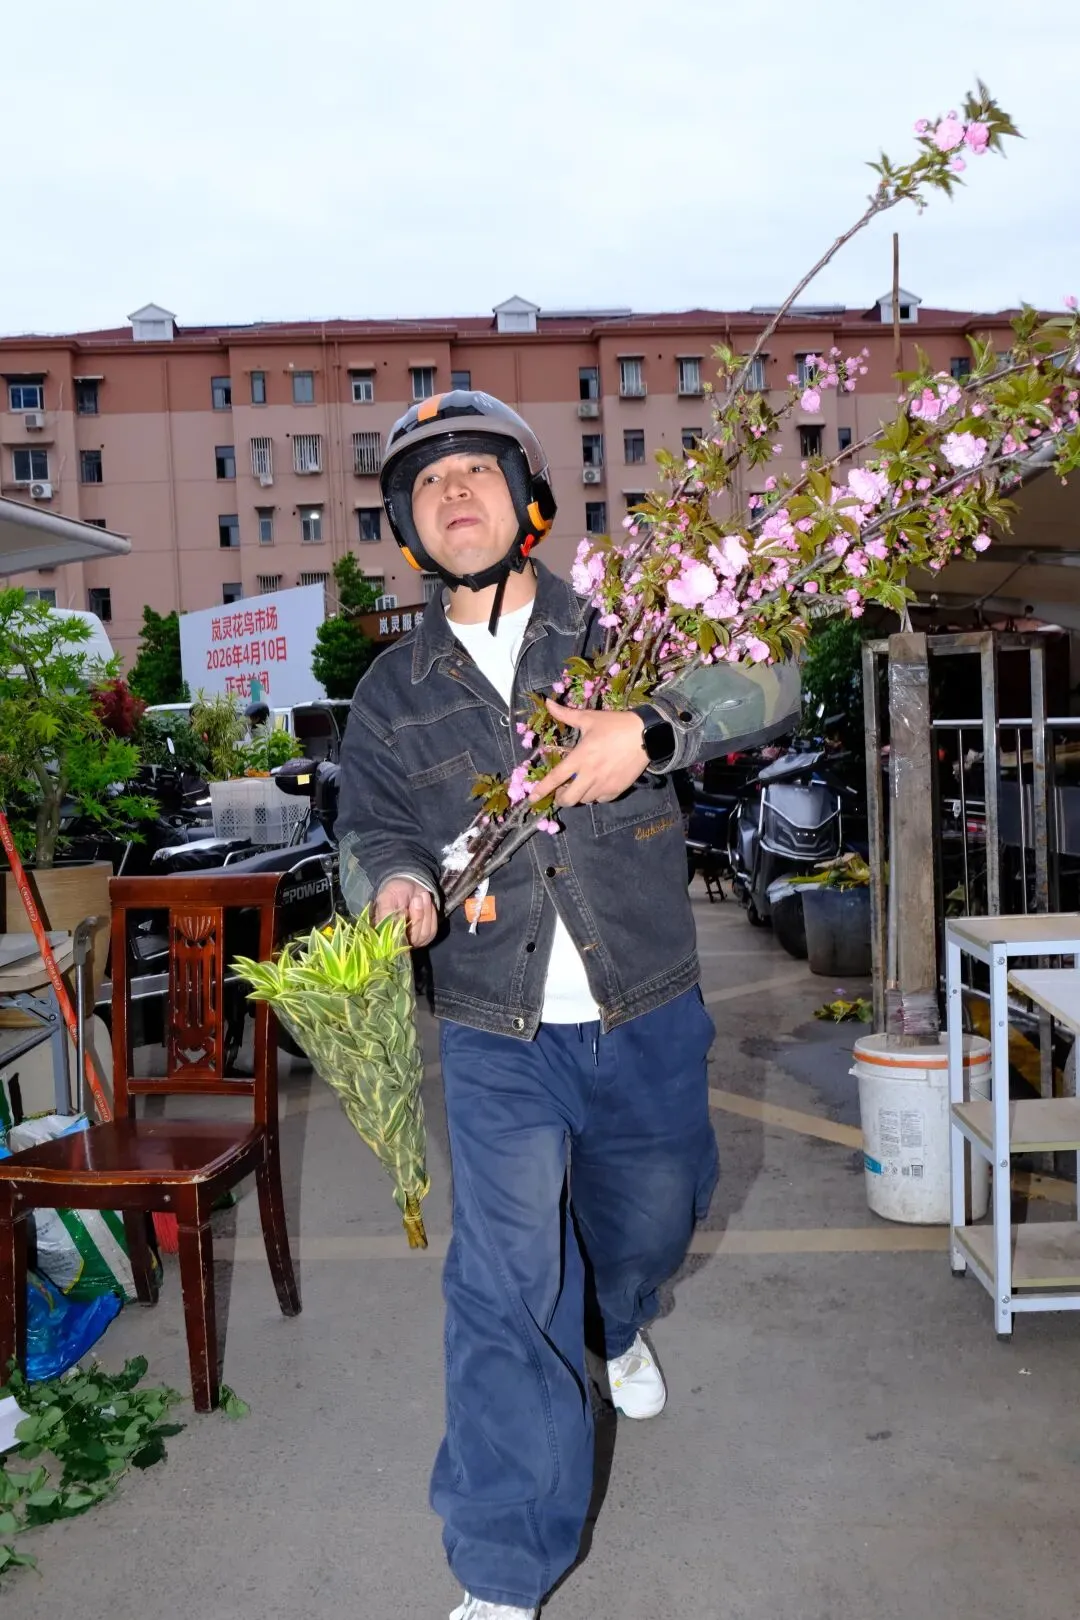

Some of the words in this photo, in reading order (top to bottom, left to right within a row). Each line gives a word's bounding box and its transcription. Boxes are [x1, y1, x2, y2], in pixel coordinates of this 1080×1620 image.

[211, 606, 278, 641] 岚灵花鸟市场
[206, 636, 287, 670] 2026年4月10日
